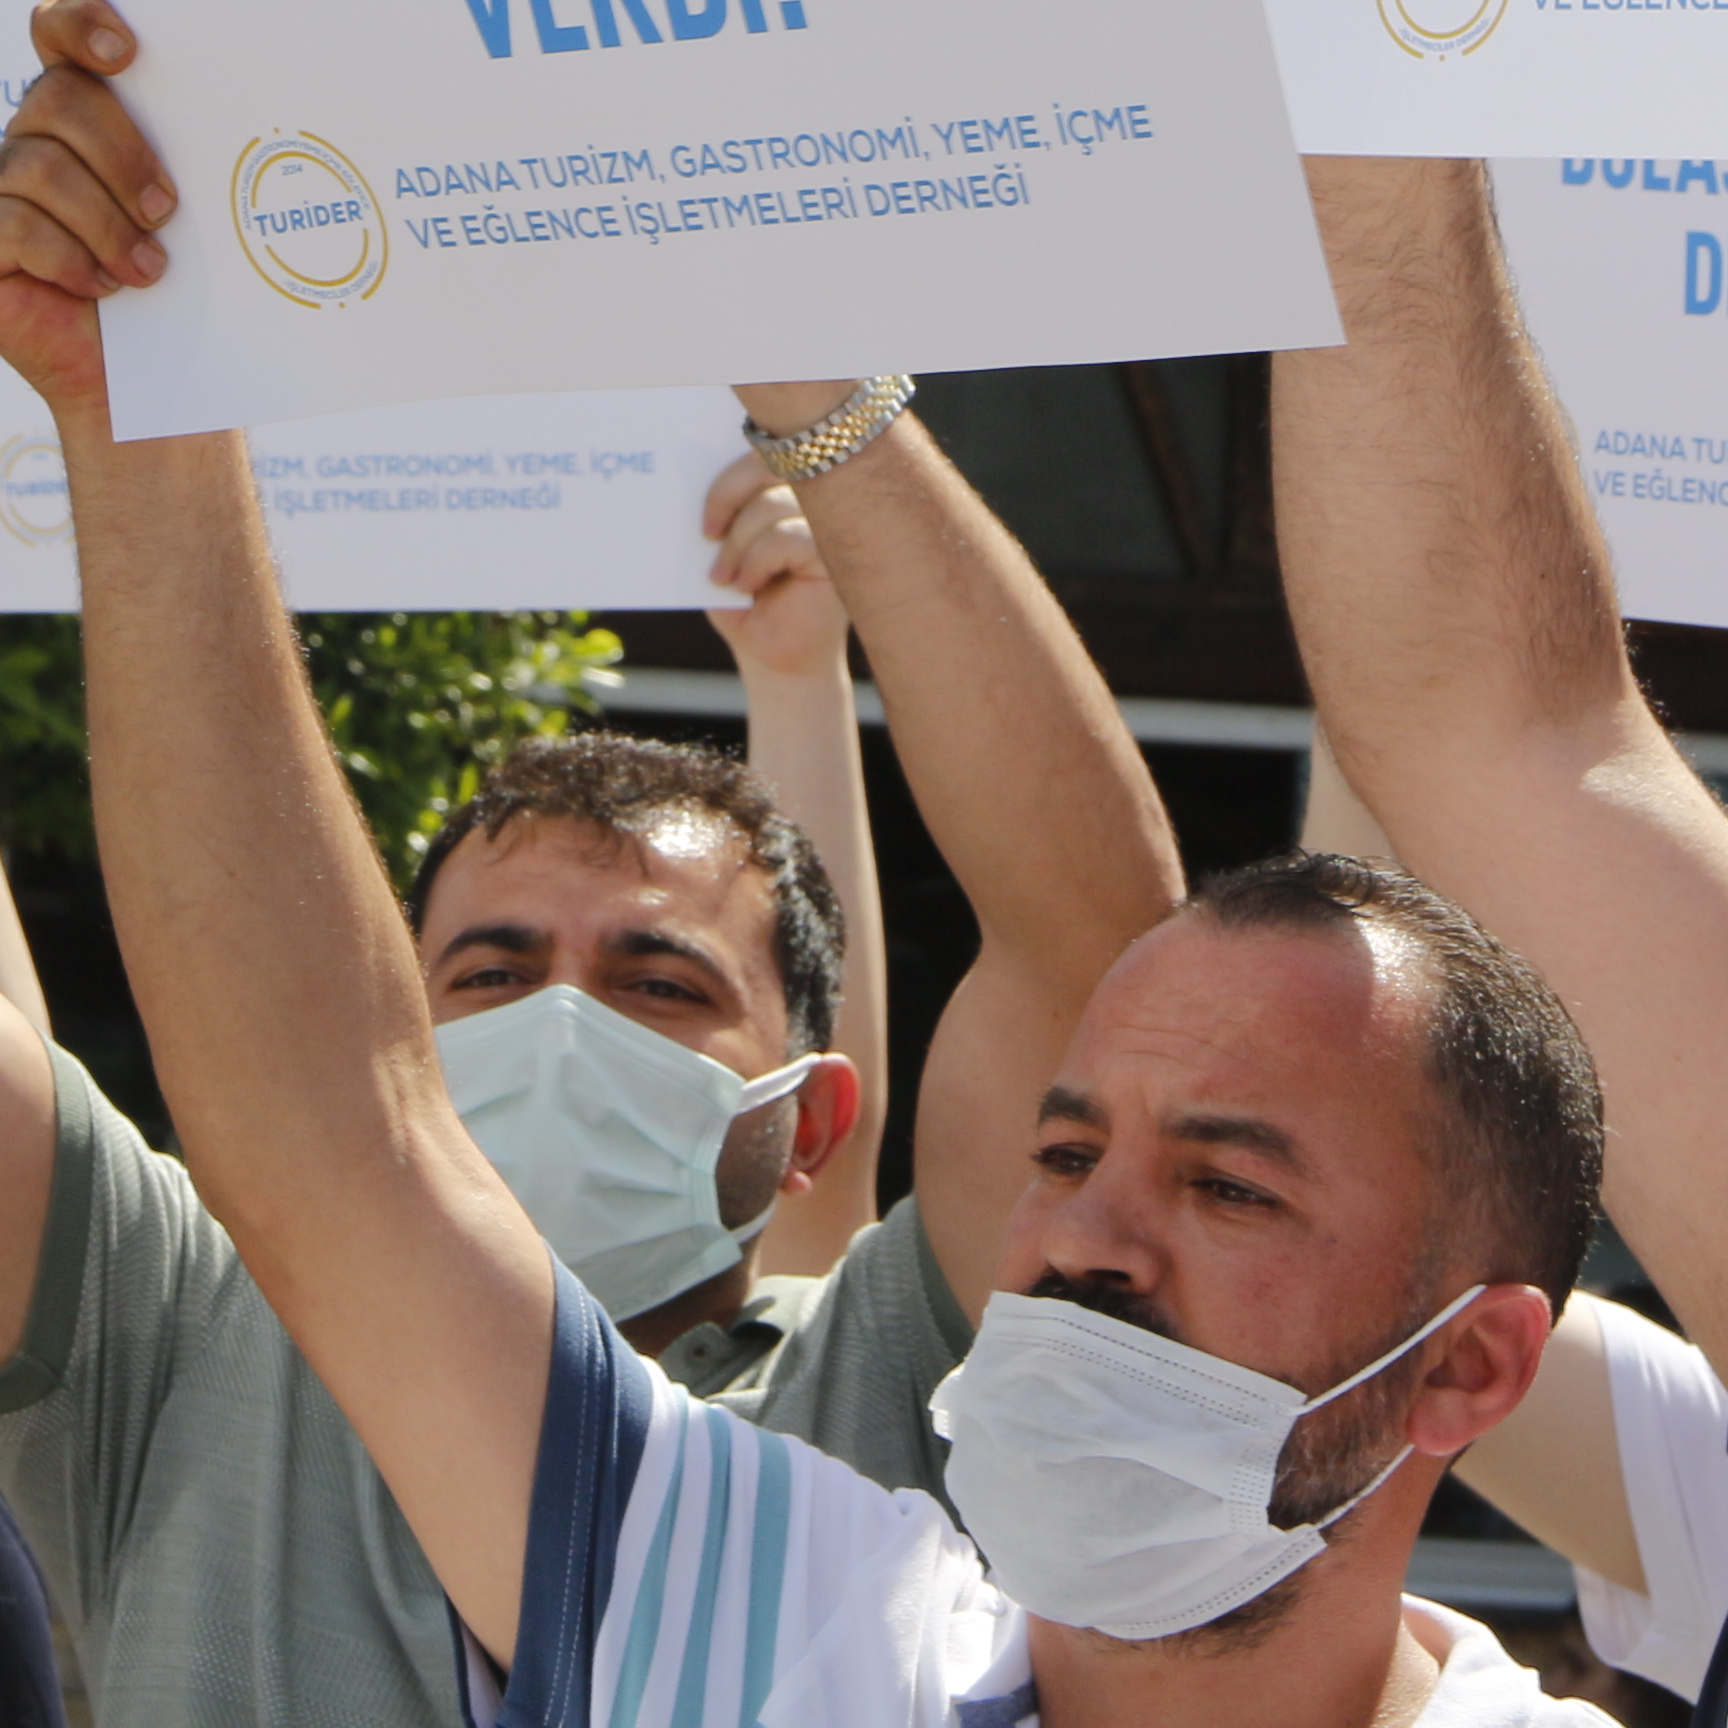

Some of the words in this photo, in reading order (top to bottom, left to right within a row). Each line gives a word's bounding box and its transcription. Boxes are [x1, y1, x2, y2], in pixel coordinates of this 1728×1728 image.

[395, 160, 521, 199] ADANA
[519, 144, 666, 189] TURİZM,
[670, 116, 931, 179] GASTRONOMİ,
[931, 114, 1052, 155] YEME,
[1052, 103, 1154, 156] İÇME
[253, 198, 363, 237] TURİDER
[405, 216, 458, 248] VE
[460, 204, 622, 246] EĞLENCE
[622, 176, 859, 245] İŞLETMELERİ
[863, 162, 1030, 217] DERNEĞİ
[1596, 430, 1686, 457] ADANA
[447, 482, 560, 509] DERNEĞİ
[1594, 470, 1626, 497] VE
